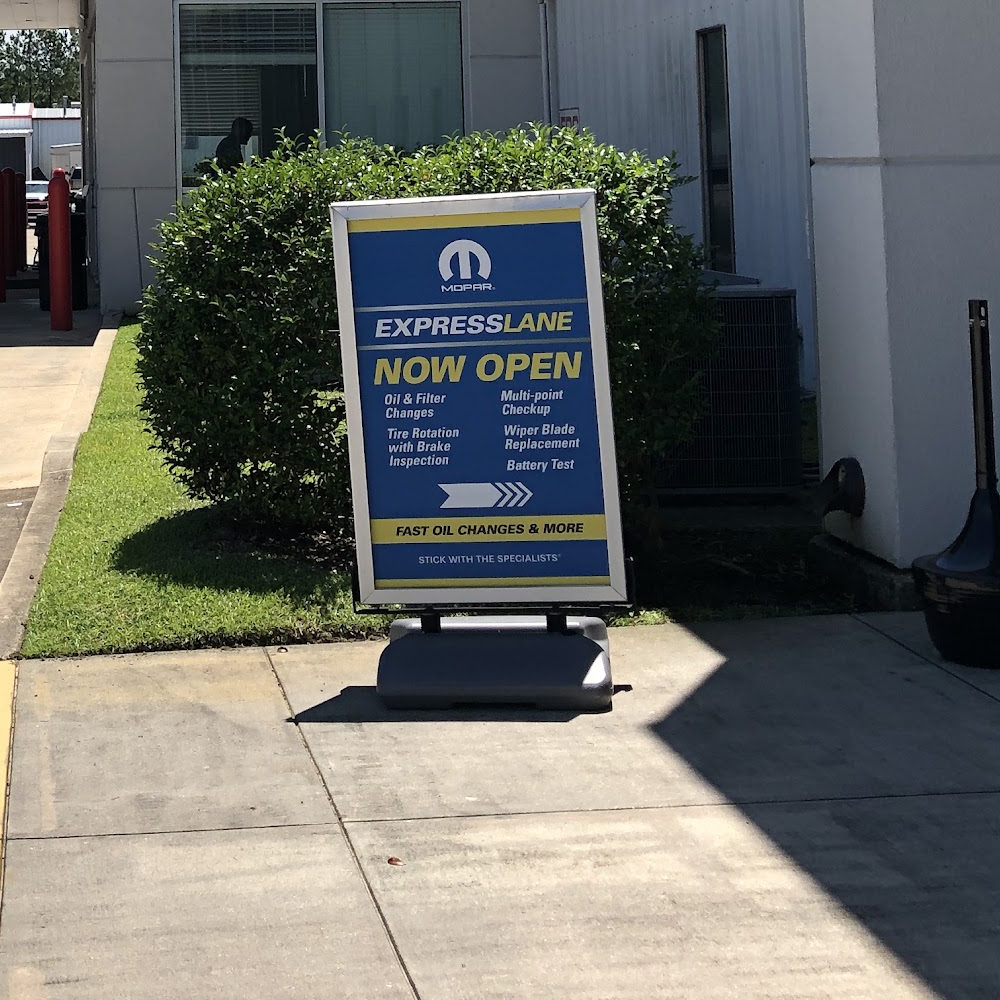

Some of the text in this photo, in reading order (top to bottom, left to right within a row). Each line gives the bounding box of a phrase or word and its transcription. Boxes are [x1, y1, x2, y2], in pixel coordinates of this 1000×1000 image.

[441, 283, 493, 292] MOPAR
[375, 311, 574, 338] EXPRESSLANE
[374, 352, 582, 385] NOW OPEN
[384, 392, 447, 405] Oil & Filter
[500, 389, 564, 403] Multi-point
[385, 407, 434, 420] Changes
[502, 403, 551, 416] Checkup
[387, 427, 460, 439] Tire Rotation
[504, 423, 576, 438] Wiper Blade
[388, 440, 451, 453] with Brake
[505, 438, 581, 452] Replacement
[389, 454, 450, 469] Inspection
[506, 458, 575, 473] Battery Test
[396, 522, 584, 536] FAST OIL CHANGES & MORE
[418, 553, 559, 564] STICK WITH THE SPECIALISTS
